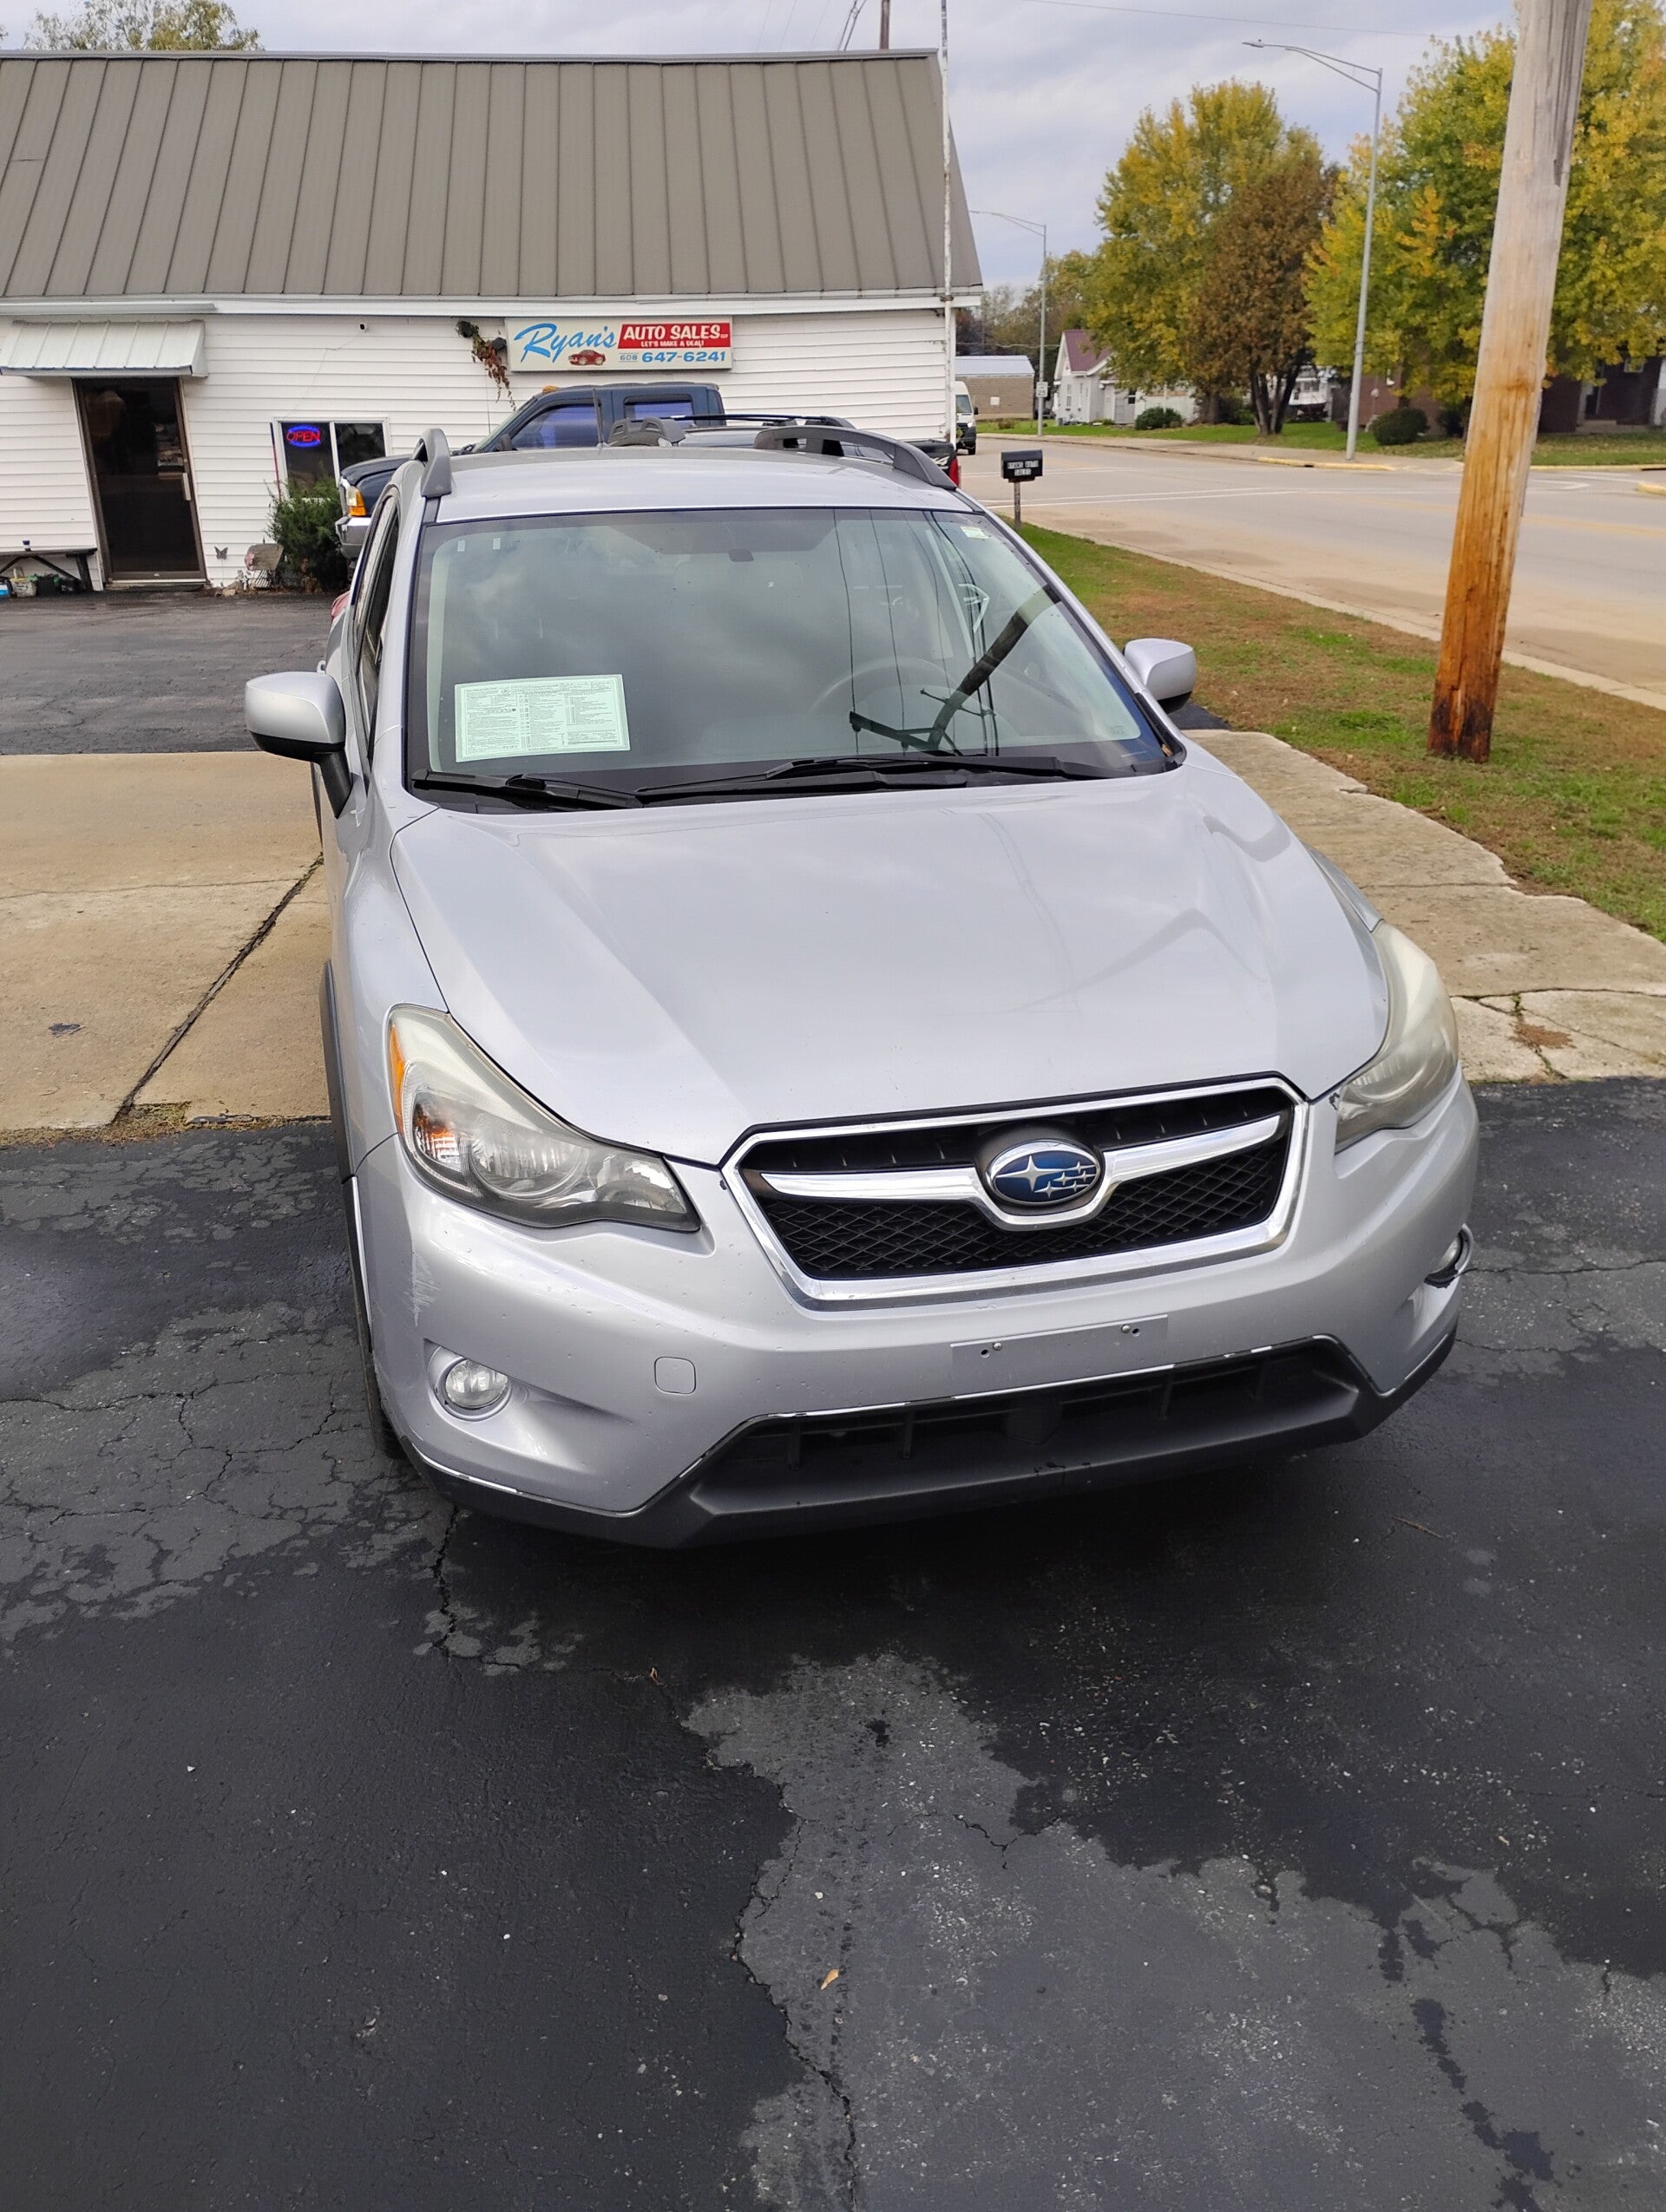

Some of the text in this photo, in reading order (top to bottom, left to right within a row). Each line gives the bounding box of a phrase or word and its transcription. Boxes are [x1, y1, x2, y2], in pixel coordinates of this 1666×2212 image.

[514, 323, 616, 363] Ryan's
[624, 325, 666, 340] AUTO
[670, 324, 720, 339] SALES
[686, 339, 705, 348] DEAL!
[642, 351, 726, 363] 647-6241
[286, 430, 320, 442] OPEN
